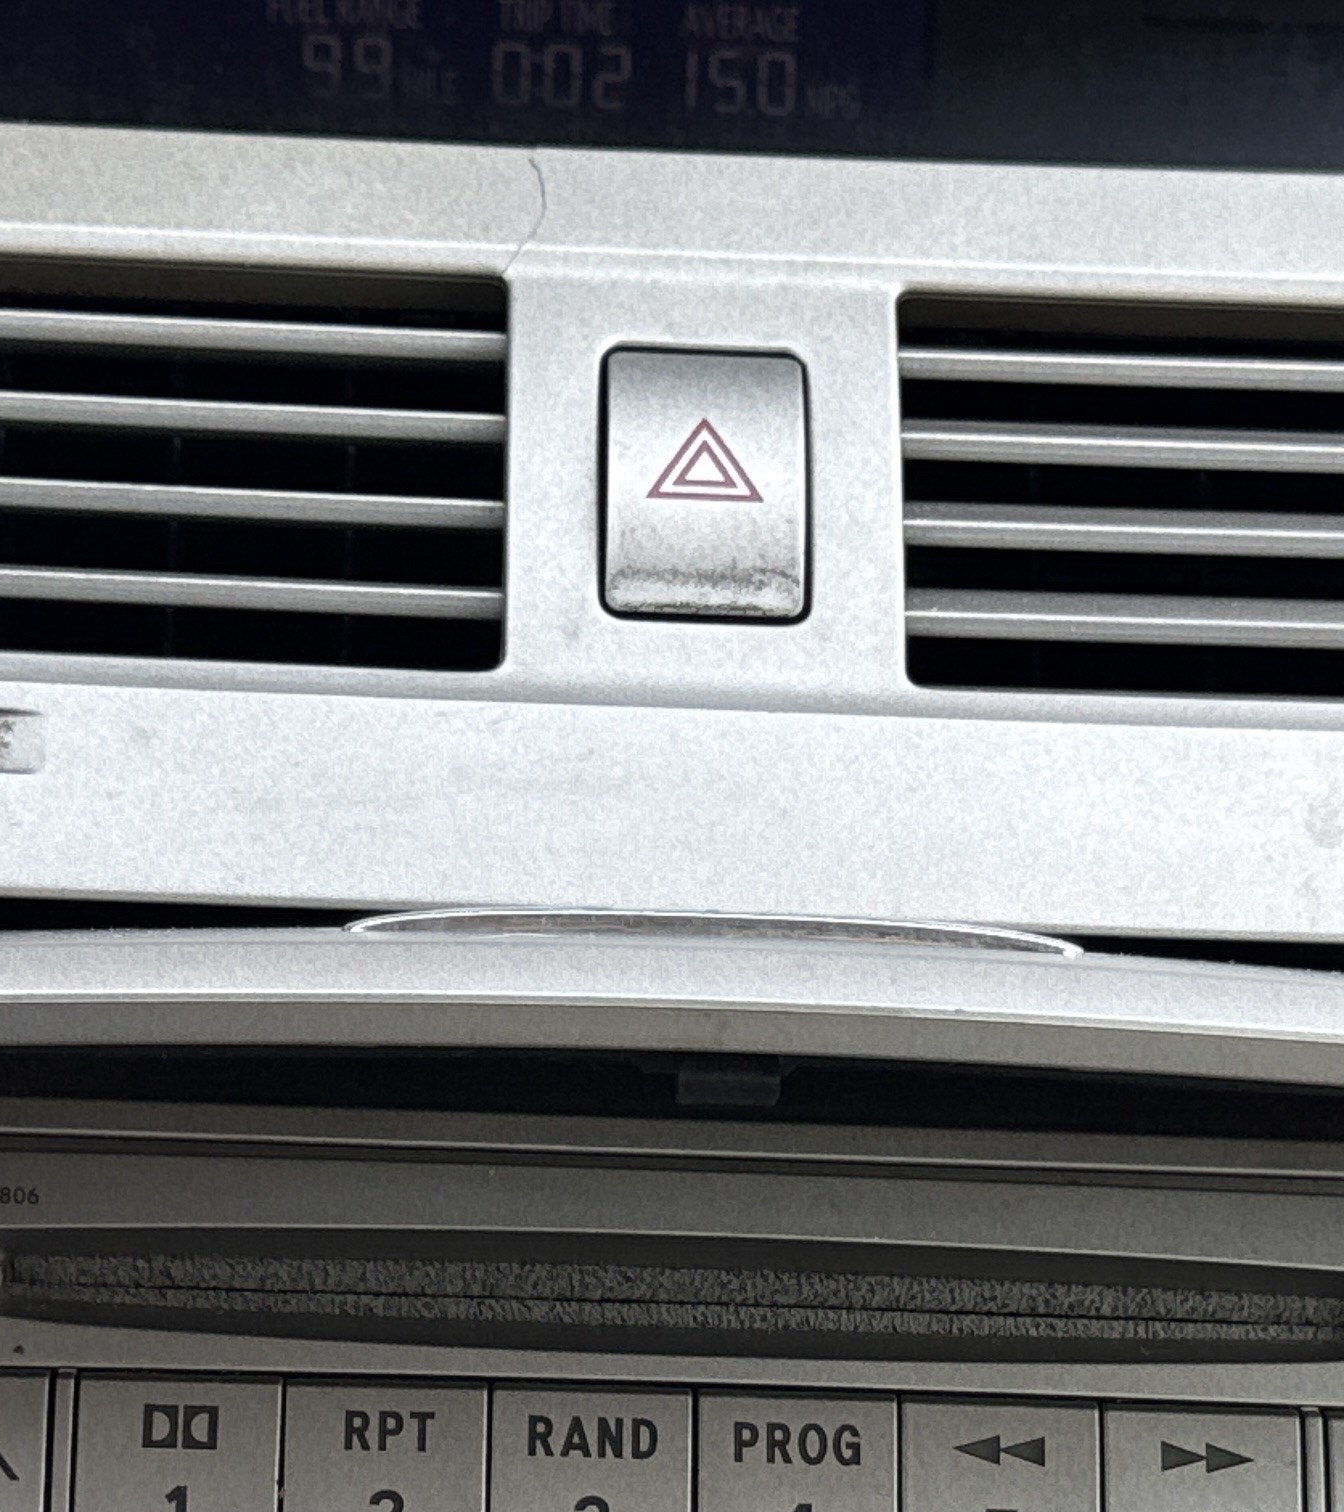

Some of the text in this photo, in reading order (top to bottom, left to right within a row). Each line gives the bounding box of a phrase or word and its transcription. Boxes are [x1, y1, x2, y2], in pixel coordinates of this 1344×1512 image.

[301, 34, 394, 100] 99
[343, 1409, 436, 1453] RPT
[527, 1414, 659, 1460] RAND
[733, 1420, 862, 1467] PROG
